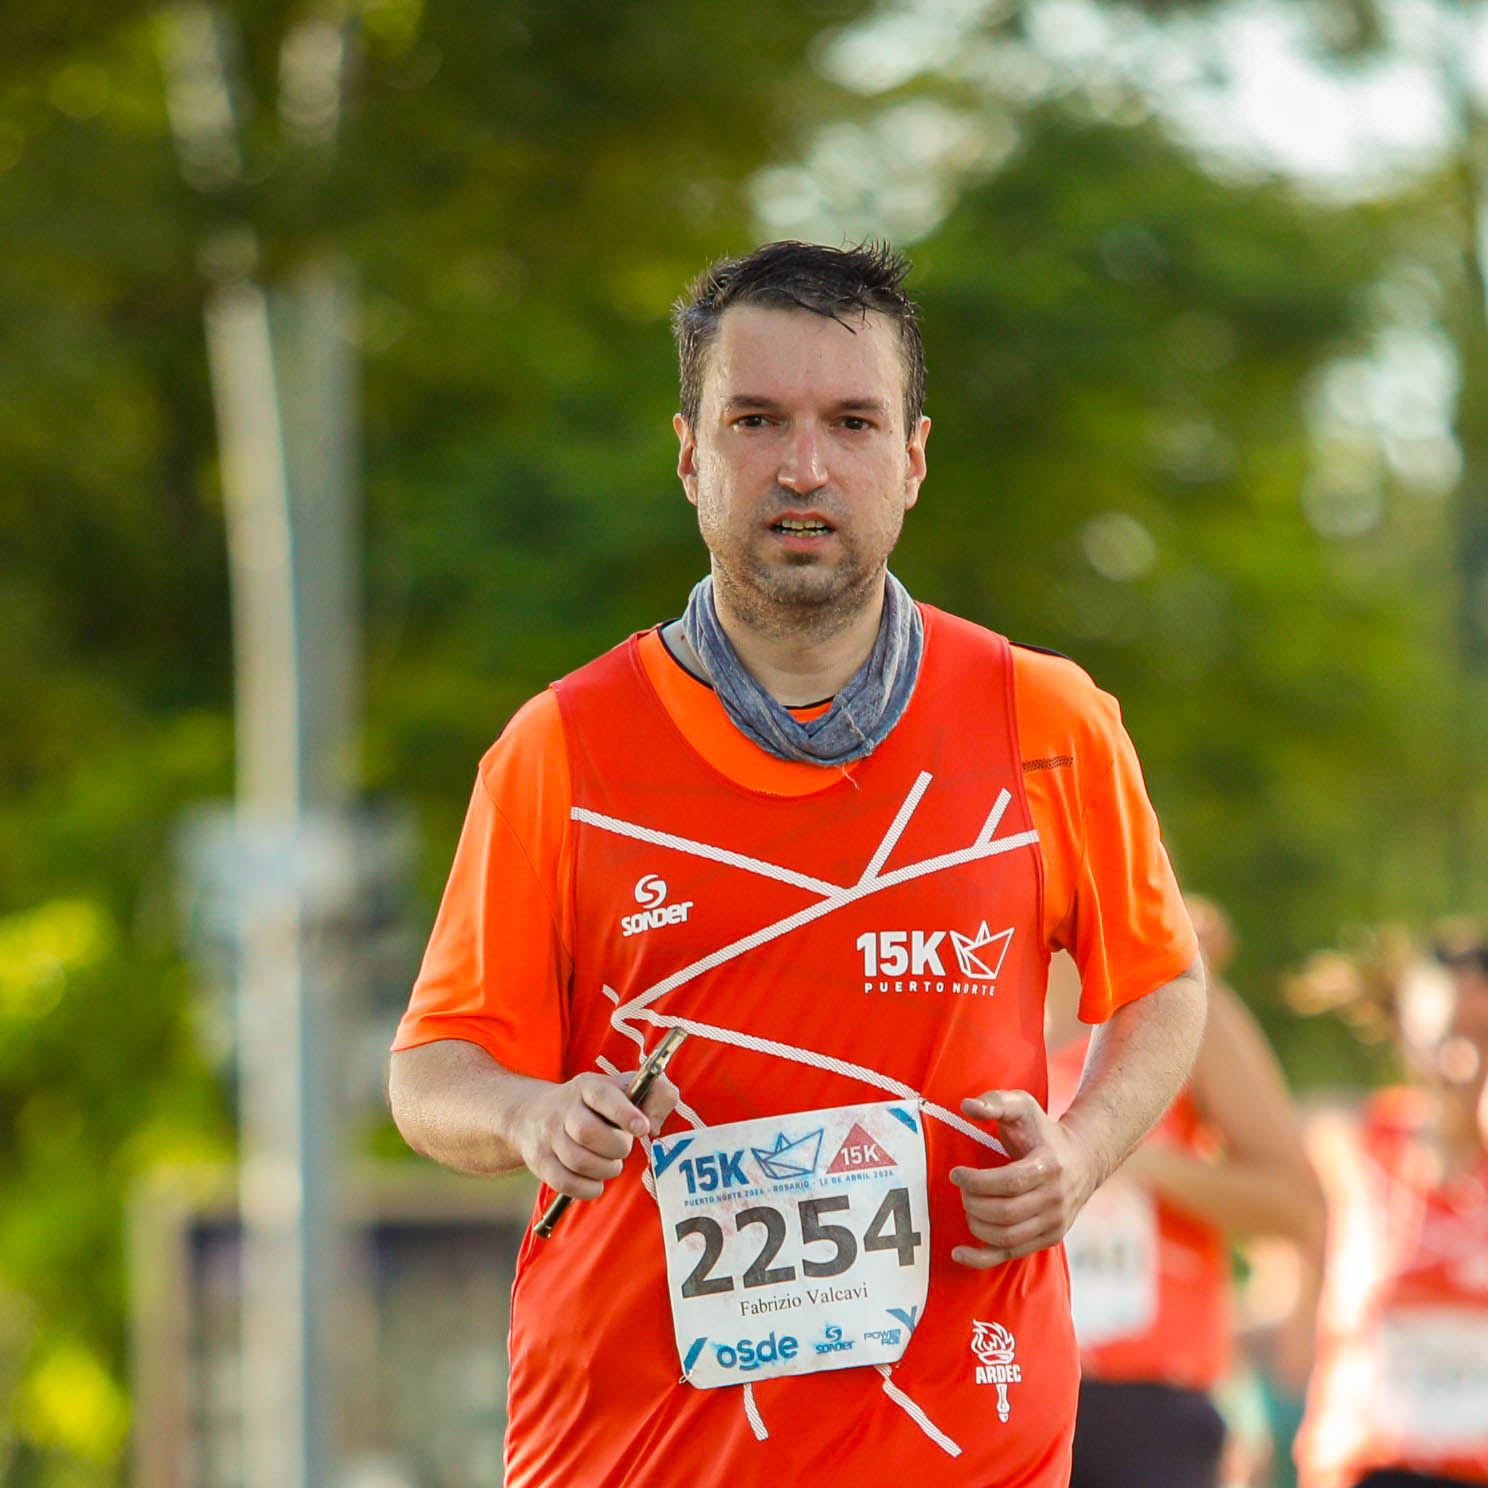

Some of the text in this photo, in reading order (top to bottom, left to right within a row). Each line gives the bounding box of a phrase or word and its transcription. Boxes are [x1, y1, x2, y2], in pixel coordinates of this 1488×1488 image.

[856, 930, 947, 977] 15K
[864, 981, 996, 996] PUERTO NORTE
[678, 1150, 750, 1194] 15K
[840, 1143, 881, 1166] 15K
[684, 1196, 715, 1207] PUERTO
[717, 1192, 742, 1202] NORTE
[773, 1180, 810, 1192] ROSARIO
[832, 1175, 843, 1185] DE
[846, 1171, 871, 1182] ABRIL
[674, 1187, 922, 1299] 2254
[739, 1282, 870, 1317] Fabrizio Valcavi
[716, 1330, 800, 1371] osde
[975, 1364, 1023, 1385] ARDEC
